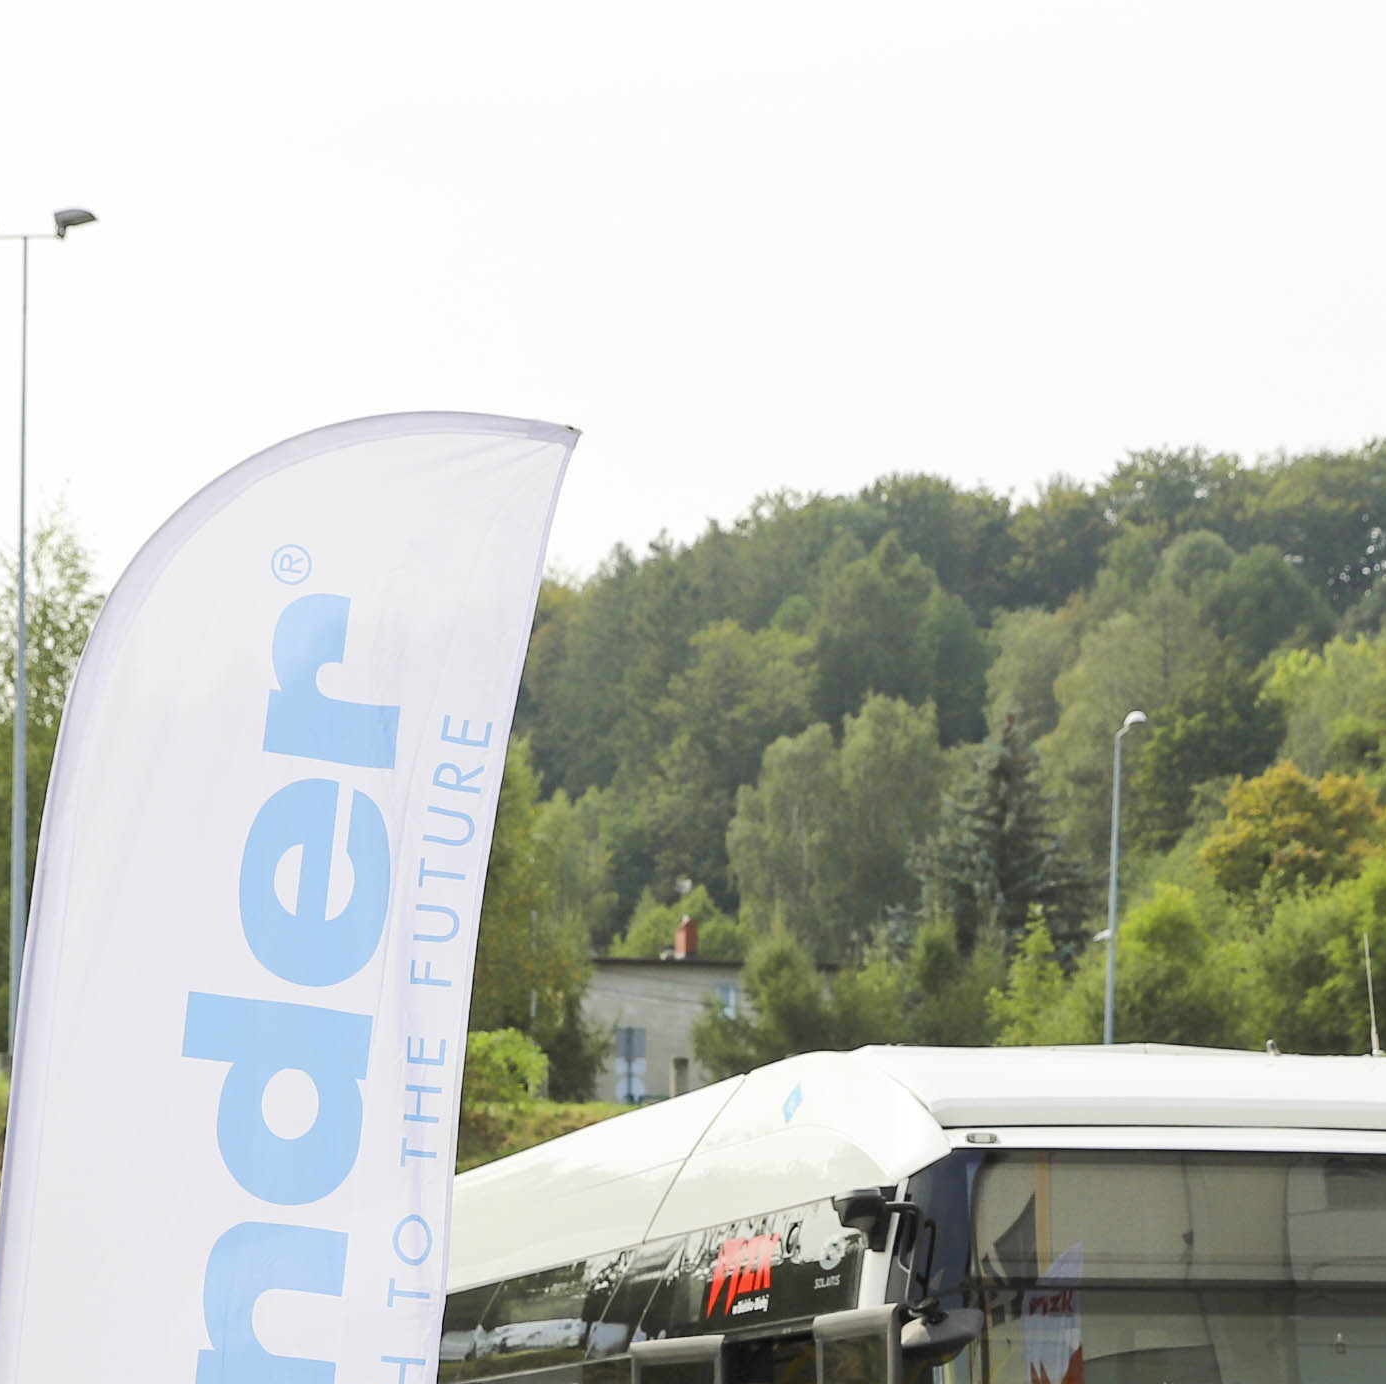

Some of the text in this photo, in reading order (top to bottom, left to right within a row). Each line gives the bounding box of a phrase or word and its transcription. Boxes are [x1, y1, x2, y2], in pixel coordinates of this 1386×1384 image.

[409, 714, 493, 988] FUTURE
[400, 1035, 447, 1167] THE
[387, 1213, 433, 1308] TO
